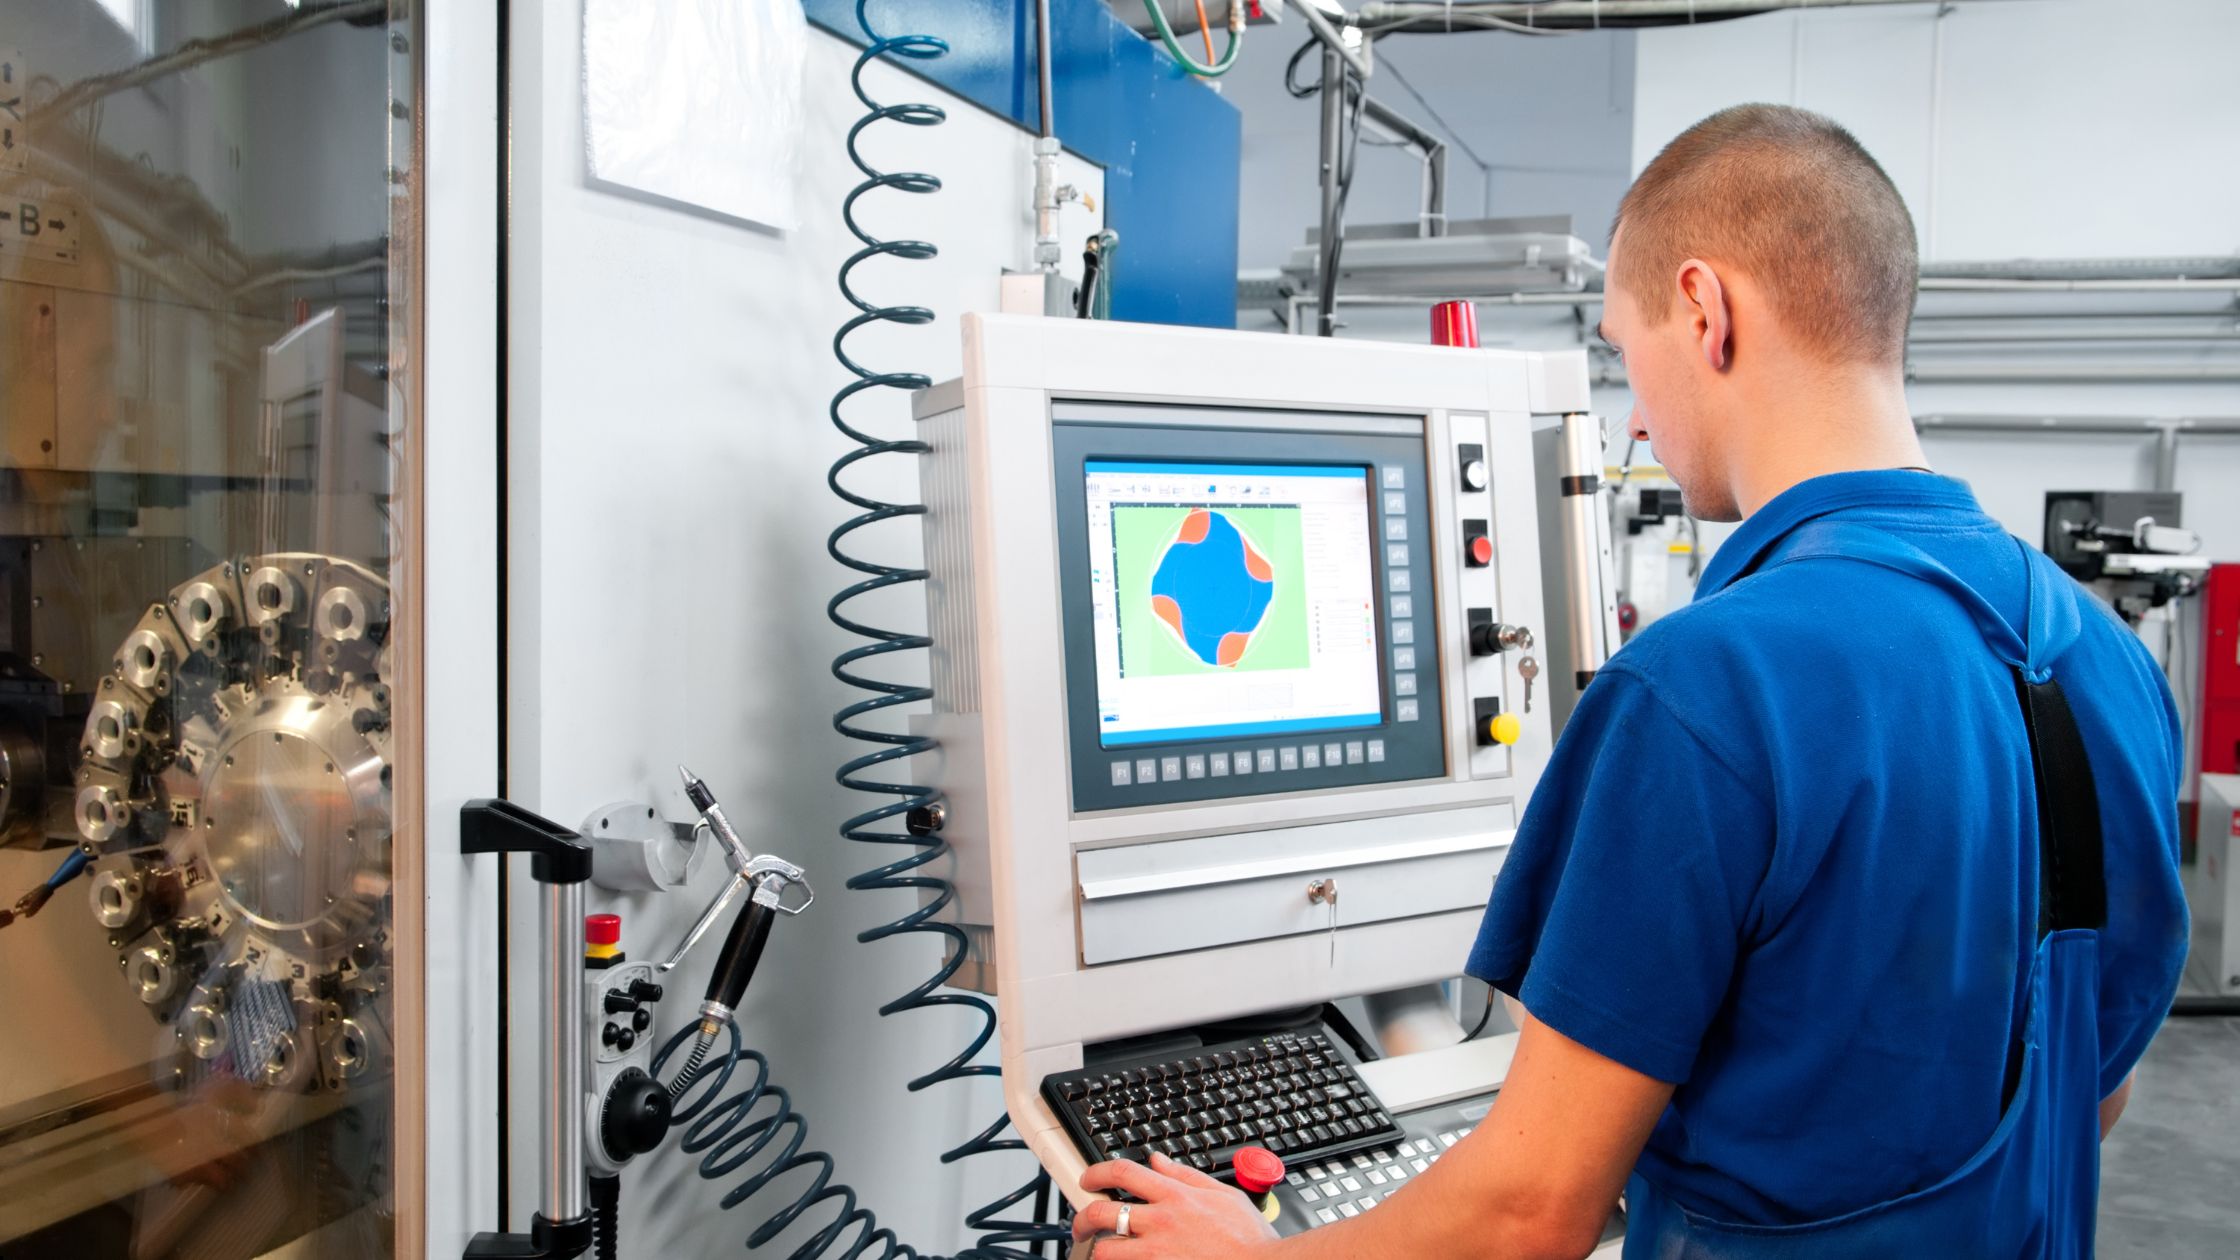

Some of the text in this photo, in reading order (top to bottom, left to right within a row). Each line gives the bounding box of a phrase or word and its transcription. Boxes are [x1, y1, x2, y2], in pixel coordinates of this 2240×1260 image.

[19, 203, 41, 236] B
[1117, 768, 1127, 778] F1
[1141, 766, 1152, 776] F2
[1191, 762, 1201, 772] F4
[1215, 760, 1225, 770] F5
[1262, 756, 1271, 766] F7
[1327, 750, 1340, 760] F10
[291, 963, 305, 979] 3
